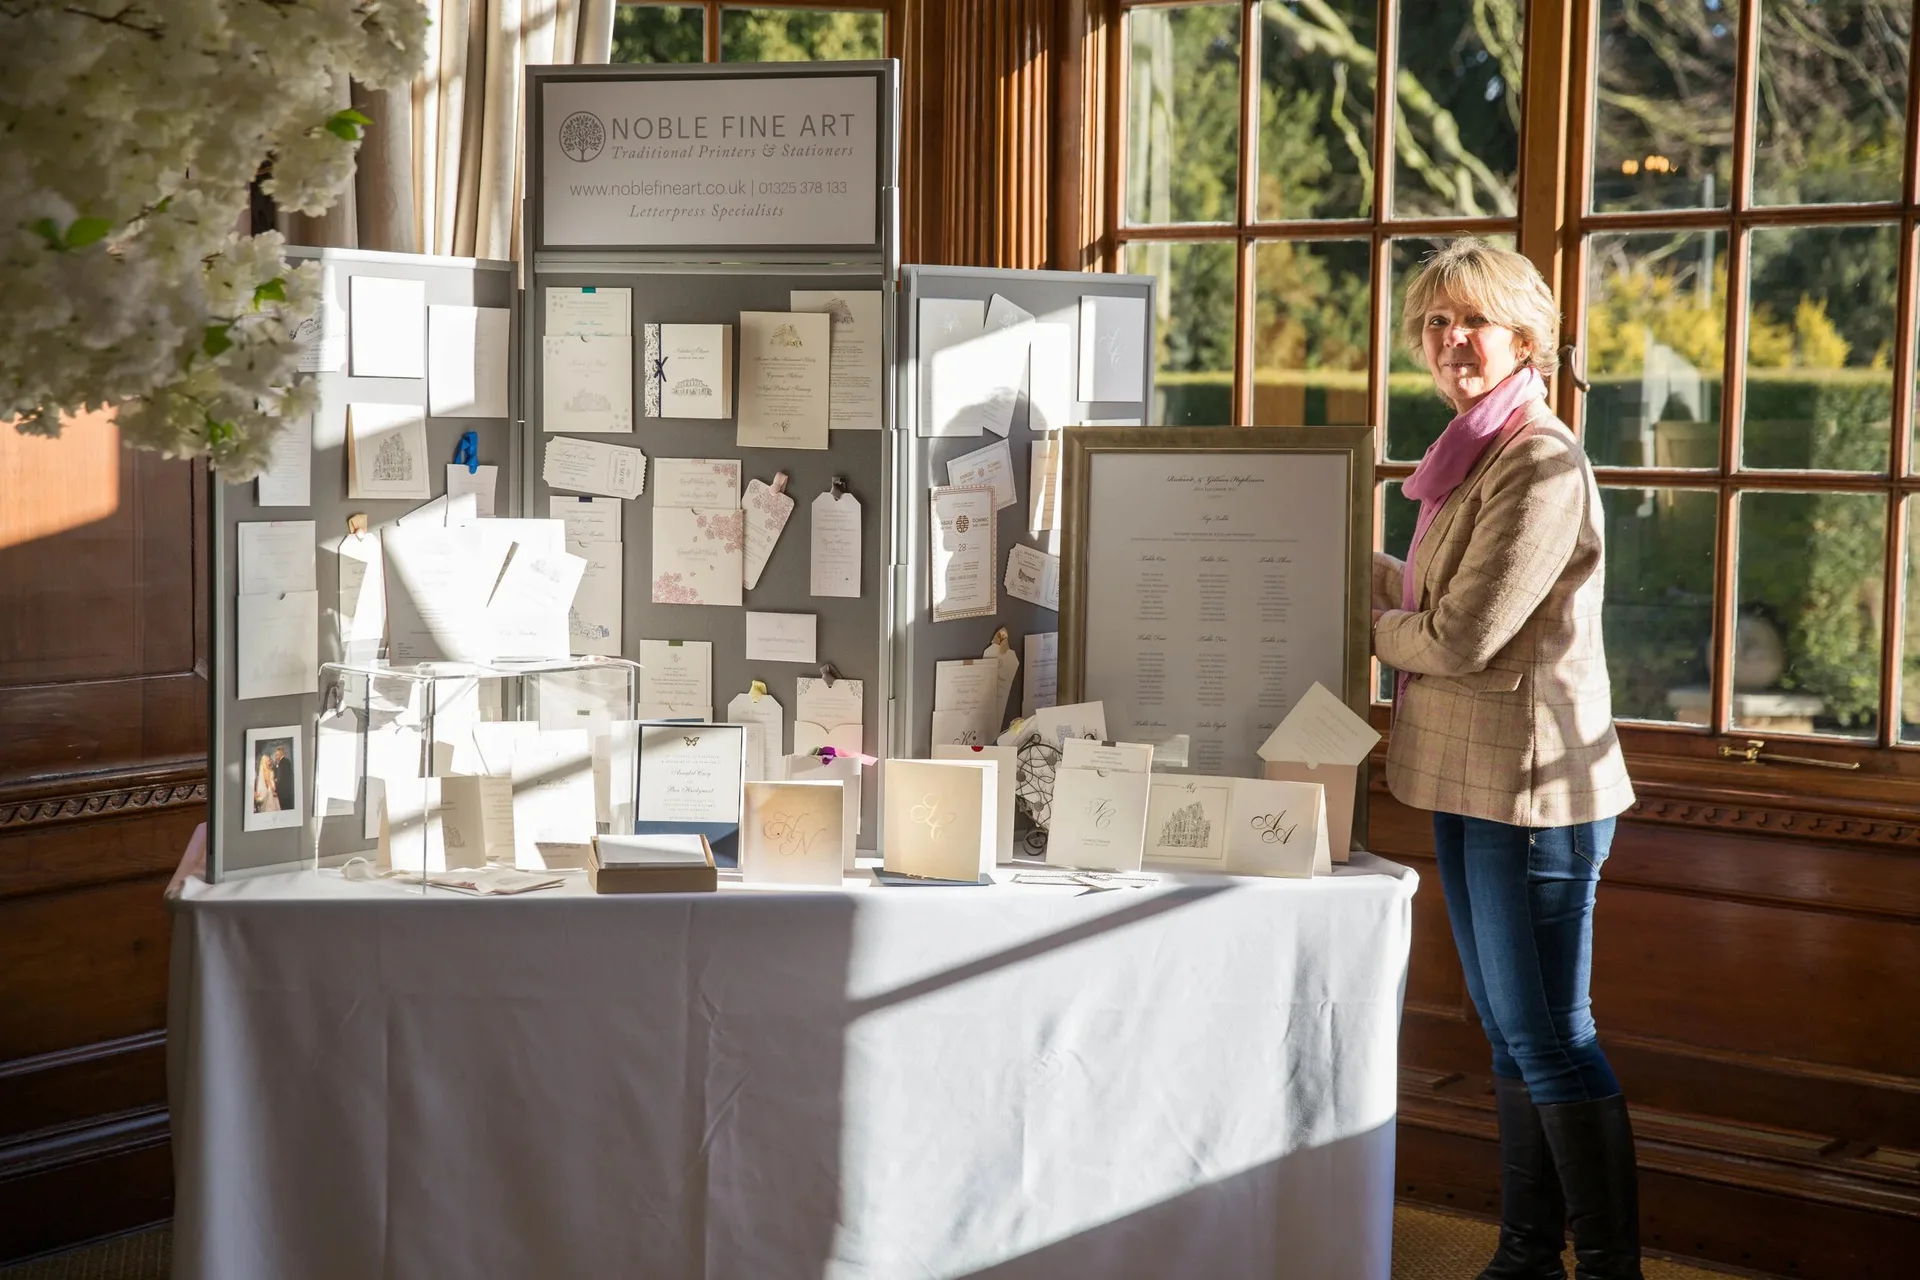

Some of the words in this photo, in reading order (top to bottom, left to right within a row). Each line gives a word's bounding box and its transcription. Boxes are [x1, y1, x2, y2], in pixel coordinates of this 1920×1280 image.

[612, 116, 708, 140] NOBLE
[722, 115, 786, 138] FINE
[800, 113, 855, 137] ART
[612, 144, 694, 160] Traditional
[699, 144, 756, 159] Printers
[762, 143, 776, 158] &
[781, 143, 854, 157] Stationers
[569, 179, 746, 197] www.noblefineart.co.uk
[758, 181, 797, 195] 01325
[800, 181, 823, 195] 378
[827, 180, 848, 195] 133
[629, 204, 706, 222] Letterpress
[711, 203, 784, 222] Specialists
